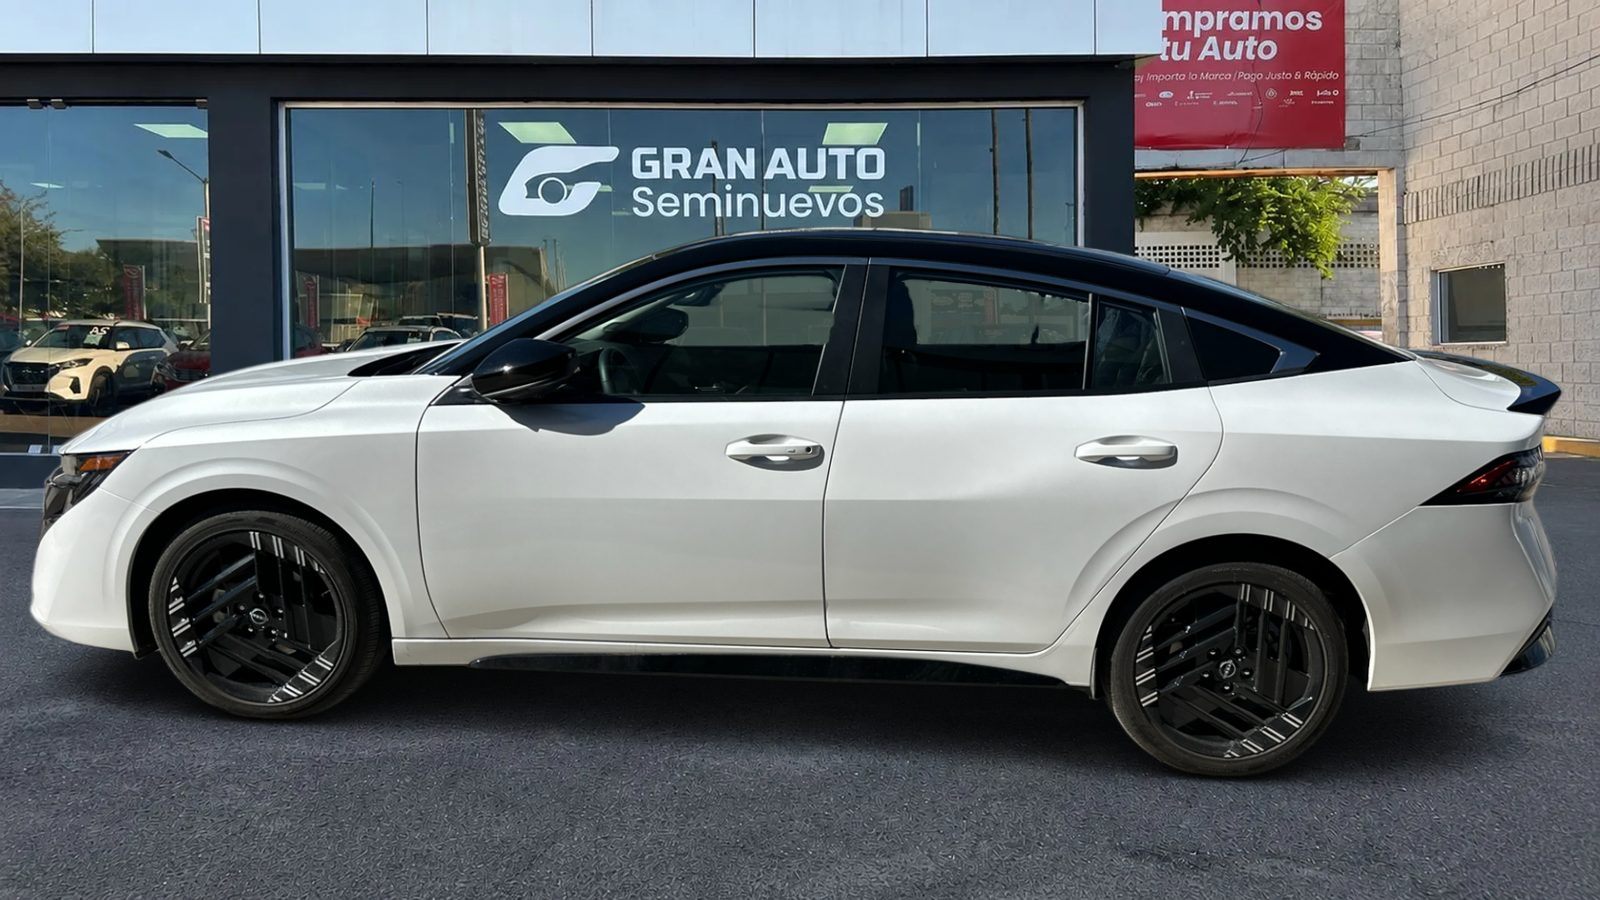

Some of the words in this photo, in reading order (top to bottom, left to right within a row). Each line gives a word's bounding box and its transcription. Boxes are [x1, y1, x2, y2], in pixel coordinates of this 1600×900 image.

[1160, 36, 1191, 61] tu
[1198, 36, 1277, 60] Auto
[1146, 72, 1186, 83] Importa
[1199, 72, 1231, 80] Marca
[1265, 71, 1292, 80] Justo
[632, 147, 755, 179] GRAN
[763, 147, 885, 179] AUTO
[632, 184, 884, 217] Seminuevos
